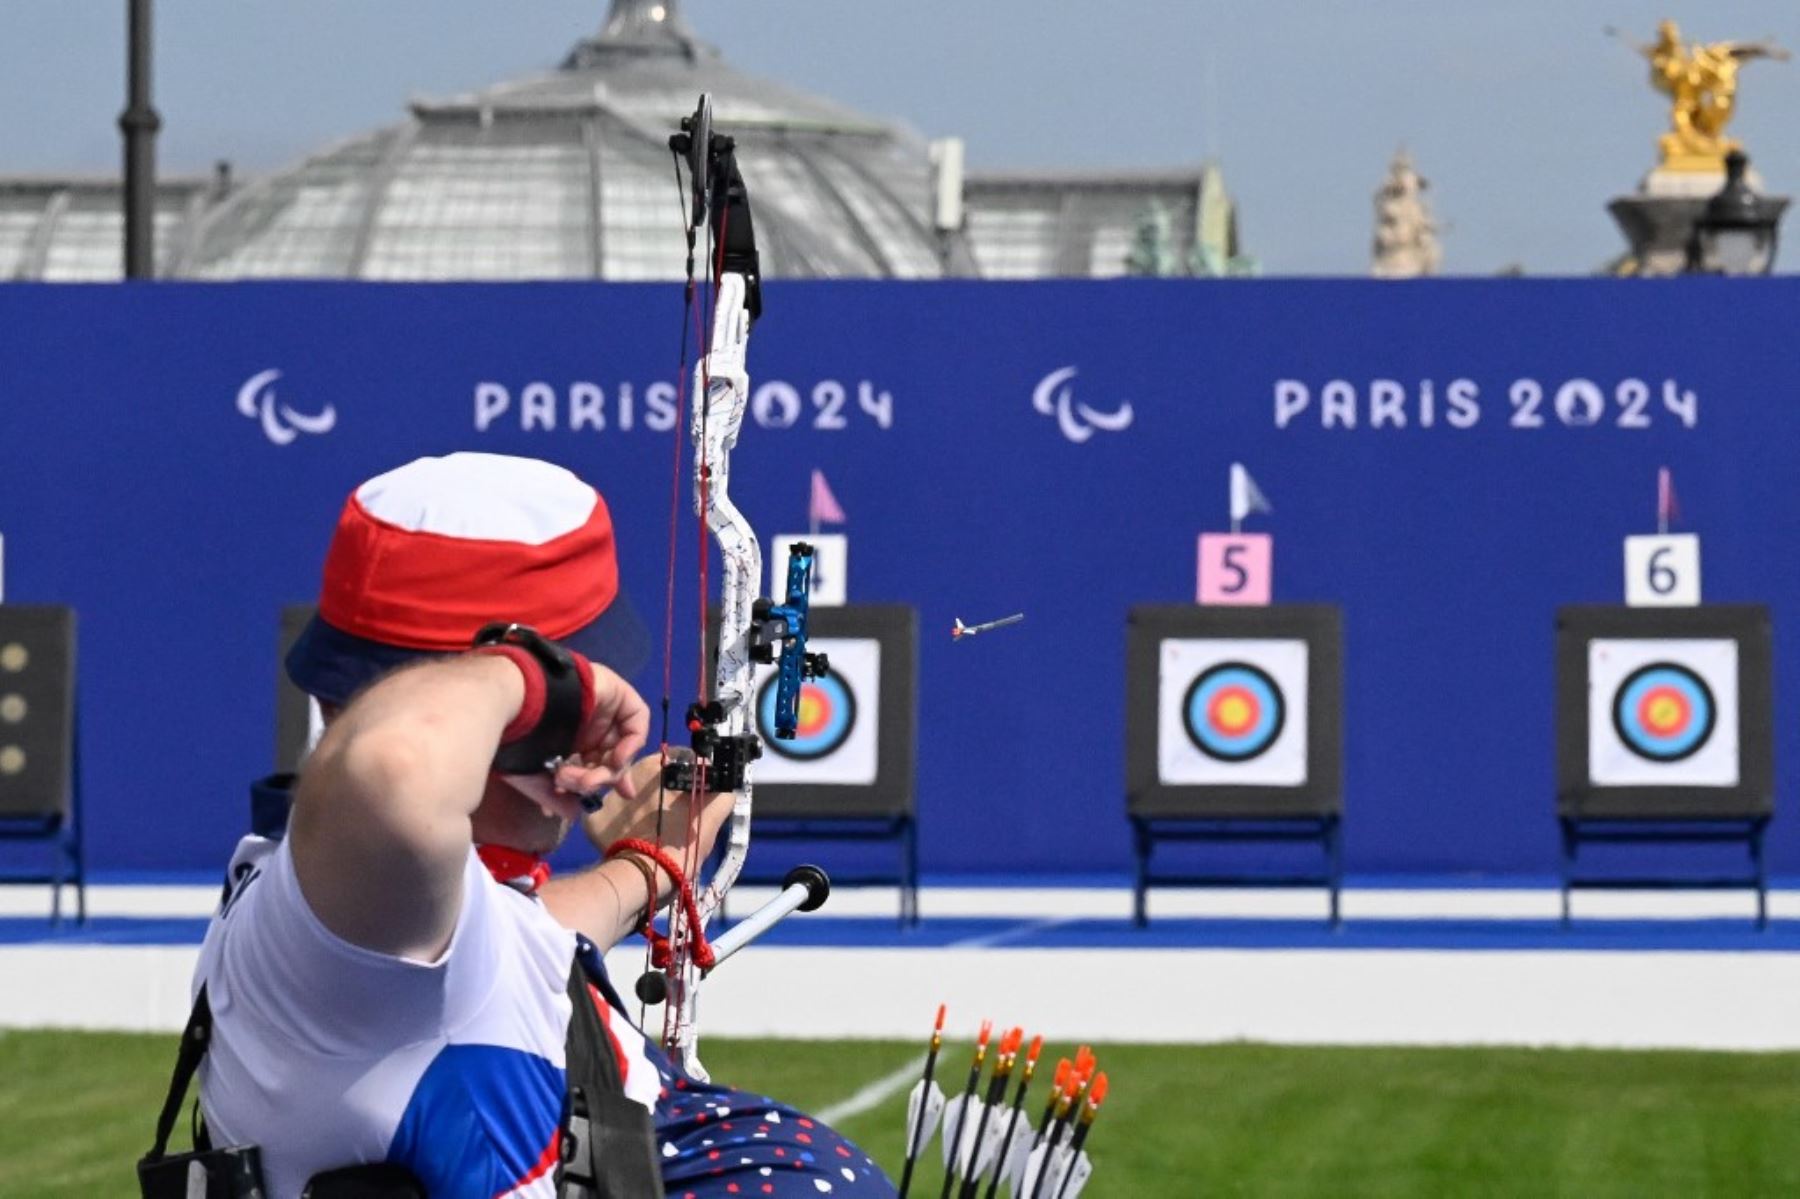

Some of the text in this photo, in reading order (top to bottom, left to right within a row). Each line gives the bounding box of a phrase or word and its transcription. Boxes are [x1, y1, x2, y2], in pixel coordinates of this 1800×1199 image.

[475, 381, 892, 430] PARIS 024
[1275, 379, 1697, 428] PARIS 2024
[1220, 545, 1248, 594] 5
[1648, 548, 1677, 595] 6
